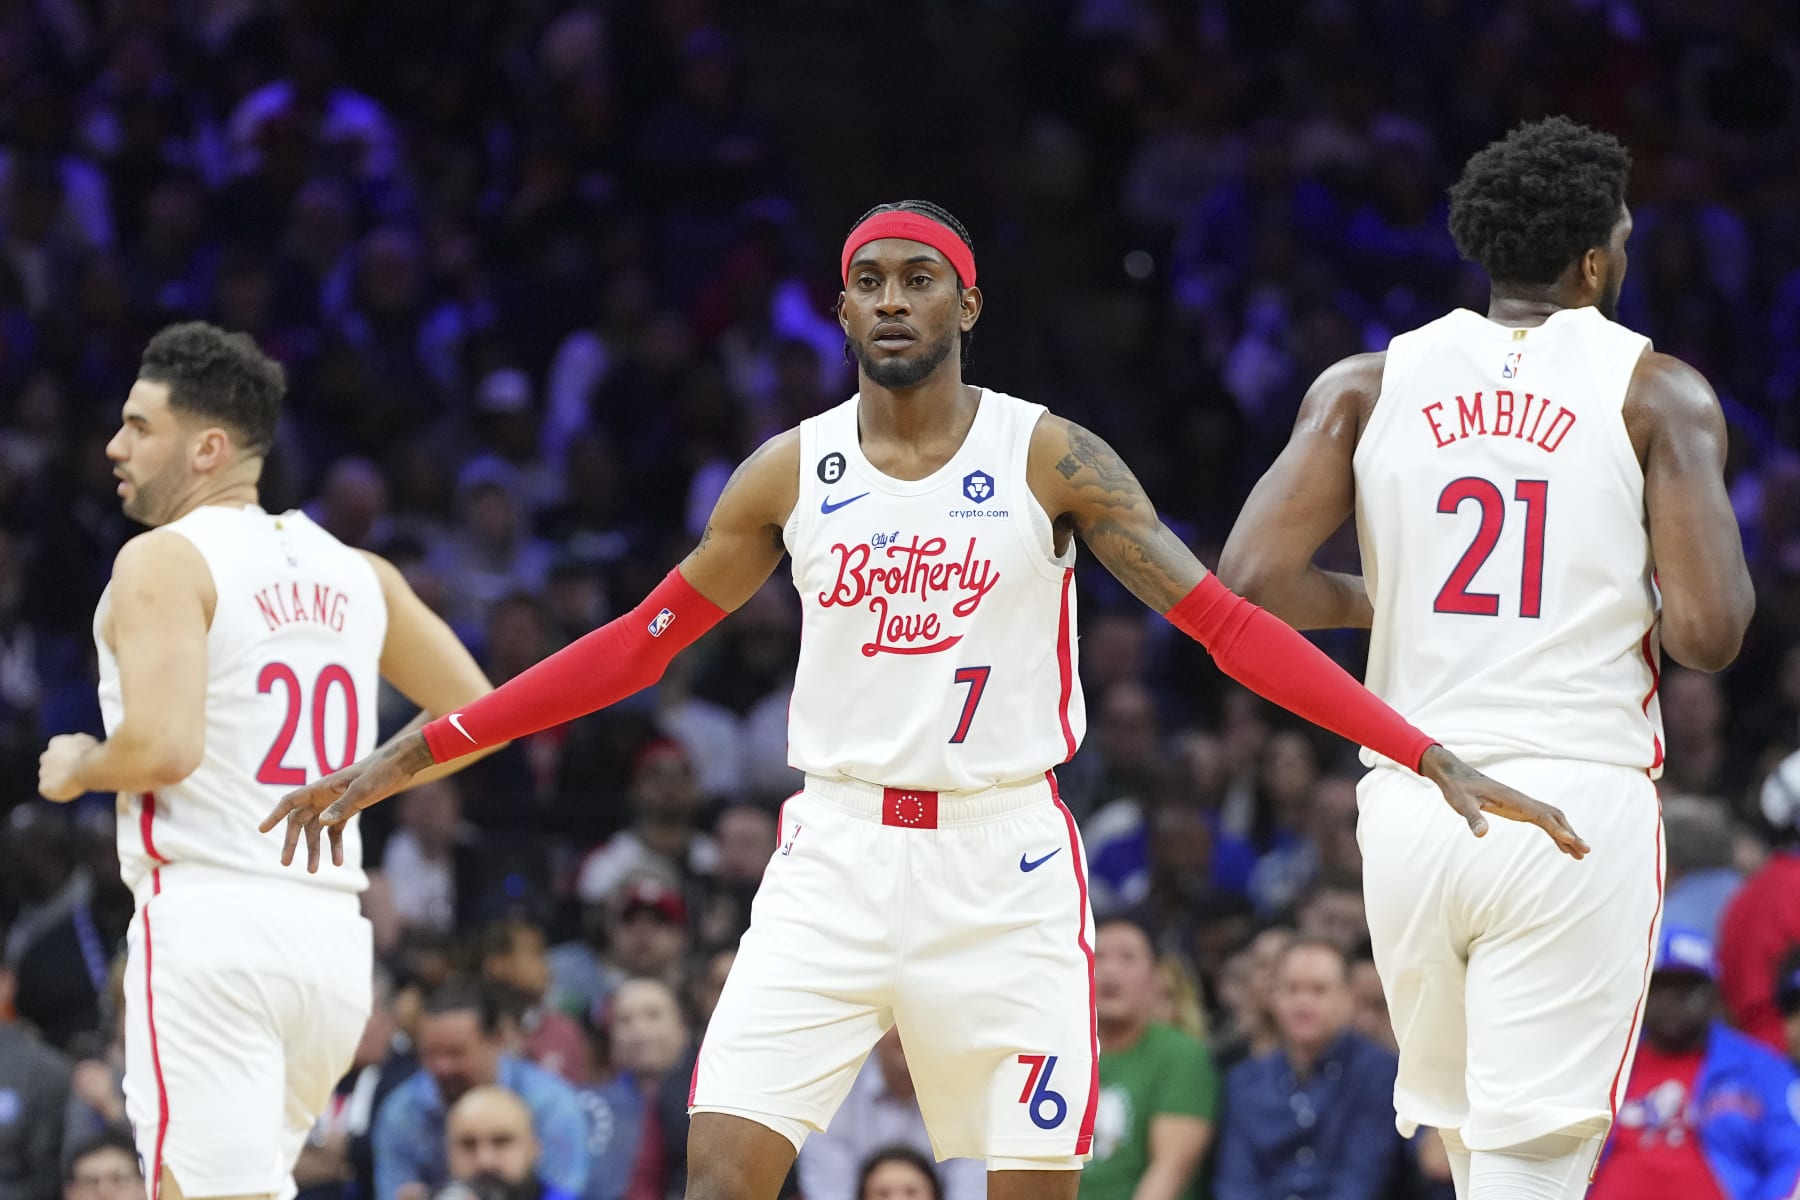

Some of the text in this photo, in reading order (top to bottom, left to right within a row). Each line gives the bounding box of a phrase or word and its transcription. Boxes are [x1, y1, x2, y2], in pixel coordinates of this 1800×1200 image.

[1422, 391, 1576, 453] EMBIID
[824, 456, 840, 480] 6
[871, 531, 900, 550] City of
[949, 510, 1009, 518] crypto.com
[818, 535, 1000, 617] Brotherly
[1433, 476, 1548, 619] 21
[255, 581, 348, 632] NIANG
[861, 596, 964, 657] Love
[256, 662, 358, 786] 20
[948, 666, 991, 743] 7
[1018, 1055, 1067, 1129] 76
